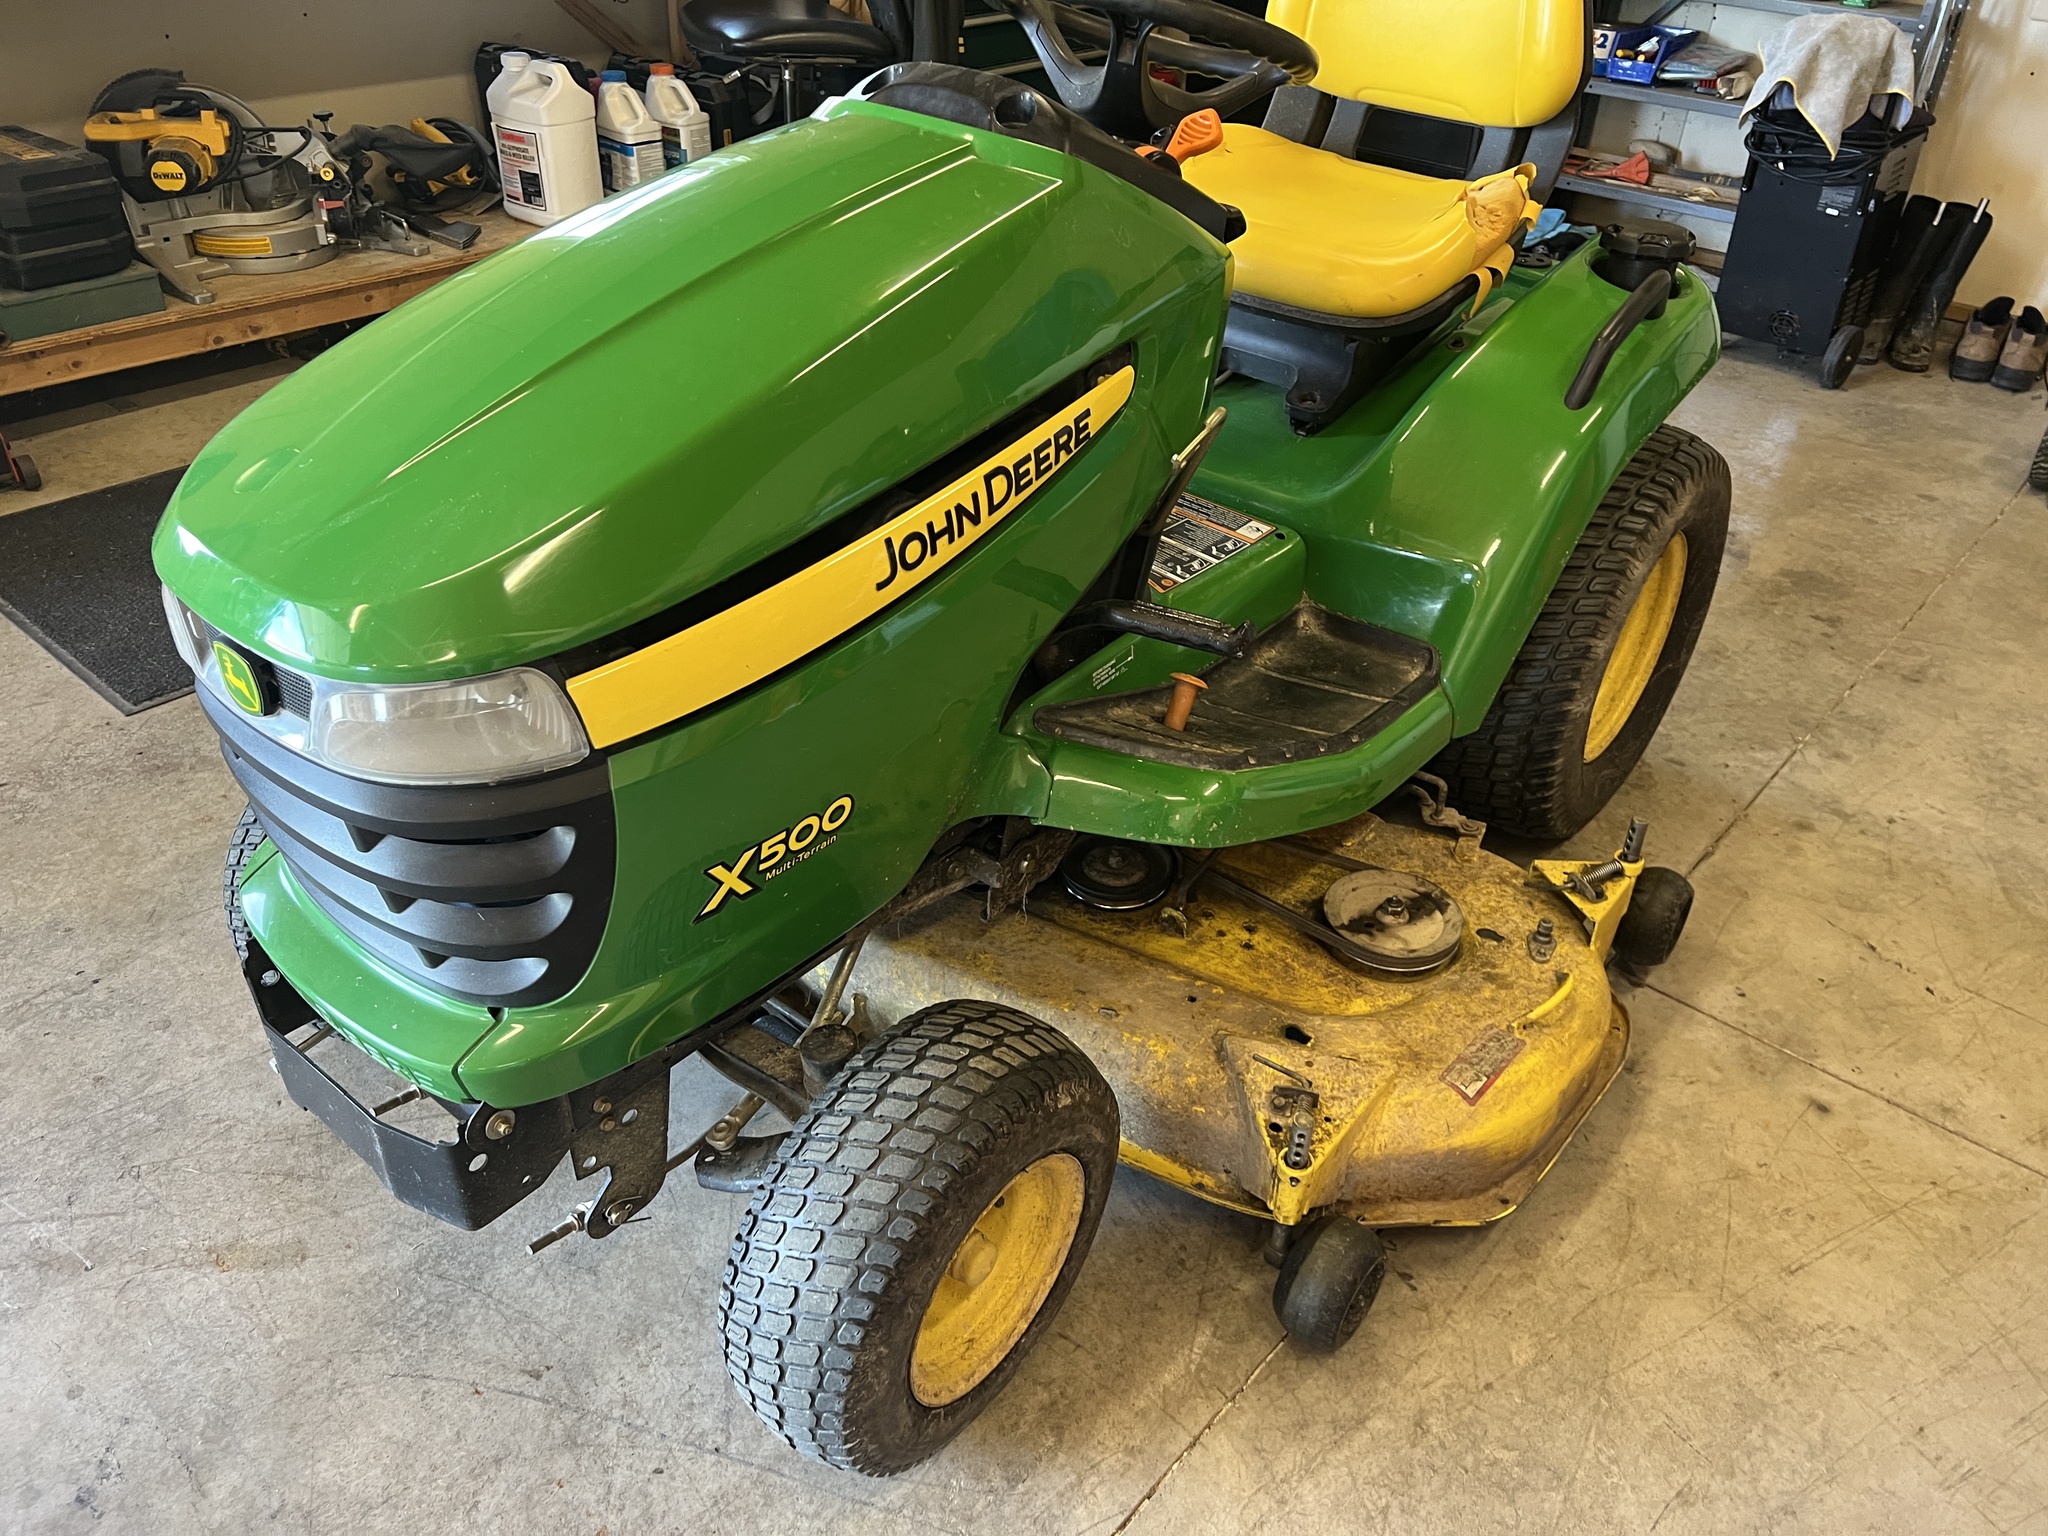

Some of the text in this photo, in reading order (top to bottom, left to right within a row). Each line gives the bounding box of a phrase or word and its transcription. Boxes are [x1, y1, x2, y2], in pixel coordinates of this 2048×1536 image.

[876, 408, 1092, 591] JOHN DEERE
[697, 795, 853, 919] X500
[765, 834, 837, 881] Multi-Terrain
